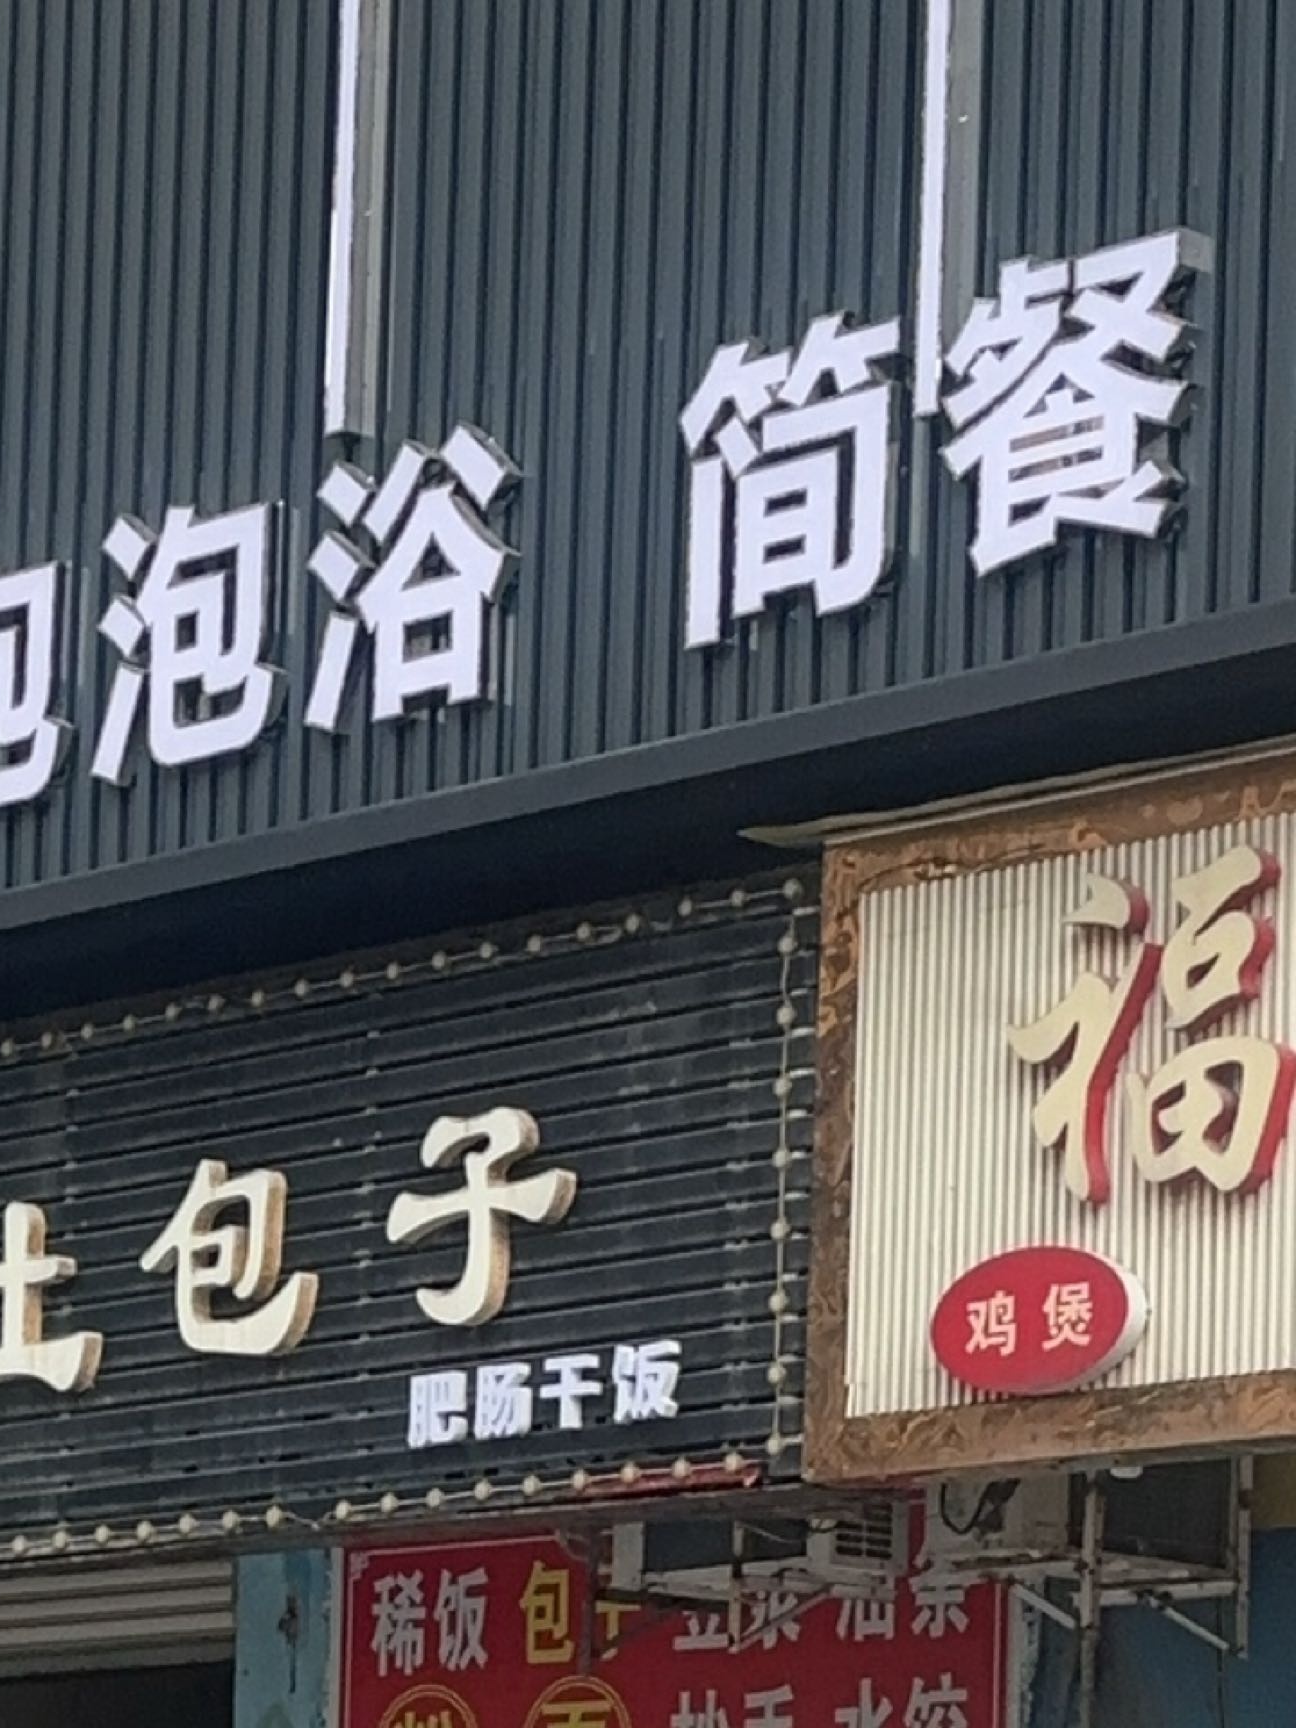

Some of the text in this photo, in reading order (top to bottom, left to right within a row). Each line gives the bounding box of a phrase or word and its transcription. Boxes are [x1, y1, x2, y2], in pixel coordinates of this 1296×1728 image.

[681, 229, 1194, 648] 简餐
[1006, 845, 1296, 1207] 福
[964, 1280, 1093, 1355] 鸡煲
[407, 1339, 681, 1449] 肥肠干饭
[371, 1567, 489, 1677] 稀饭
